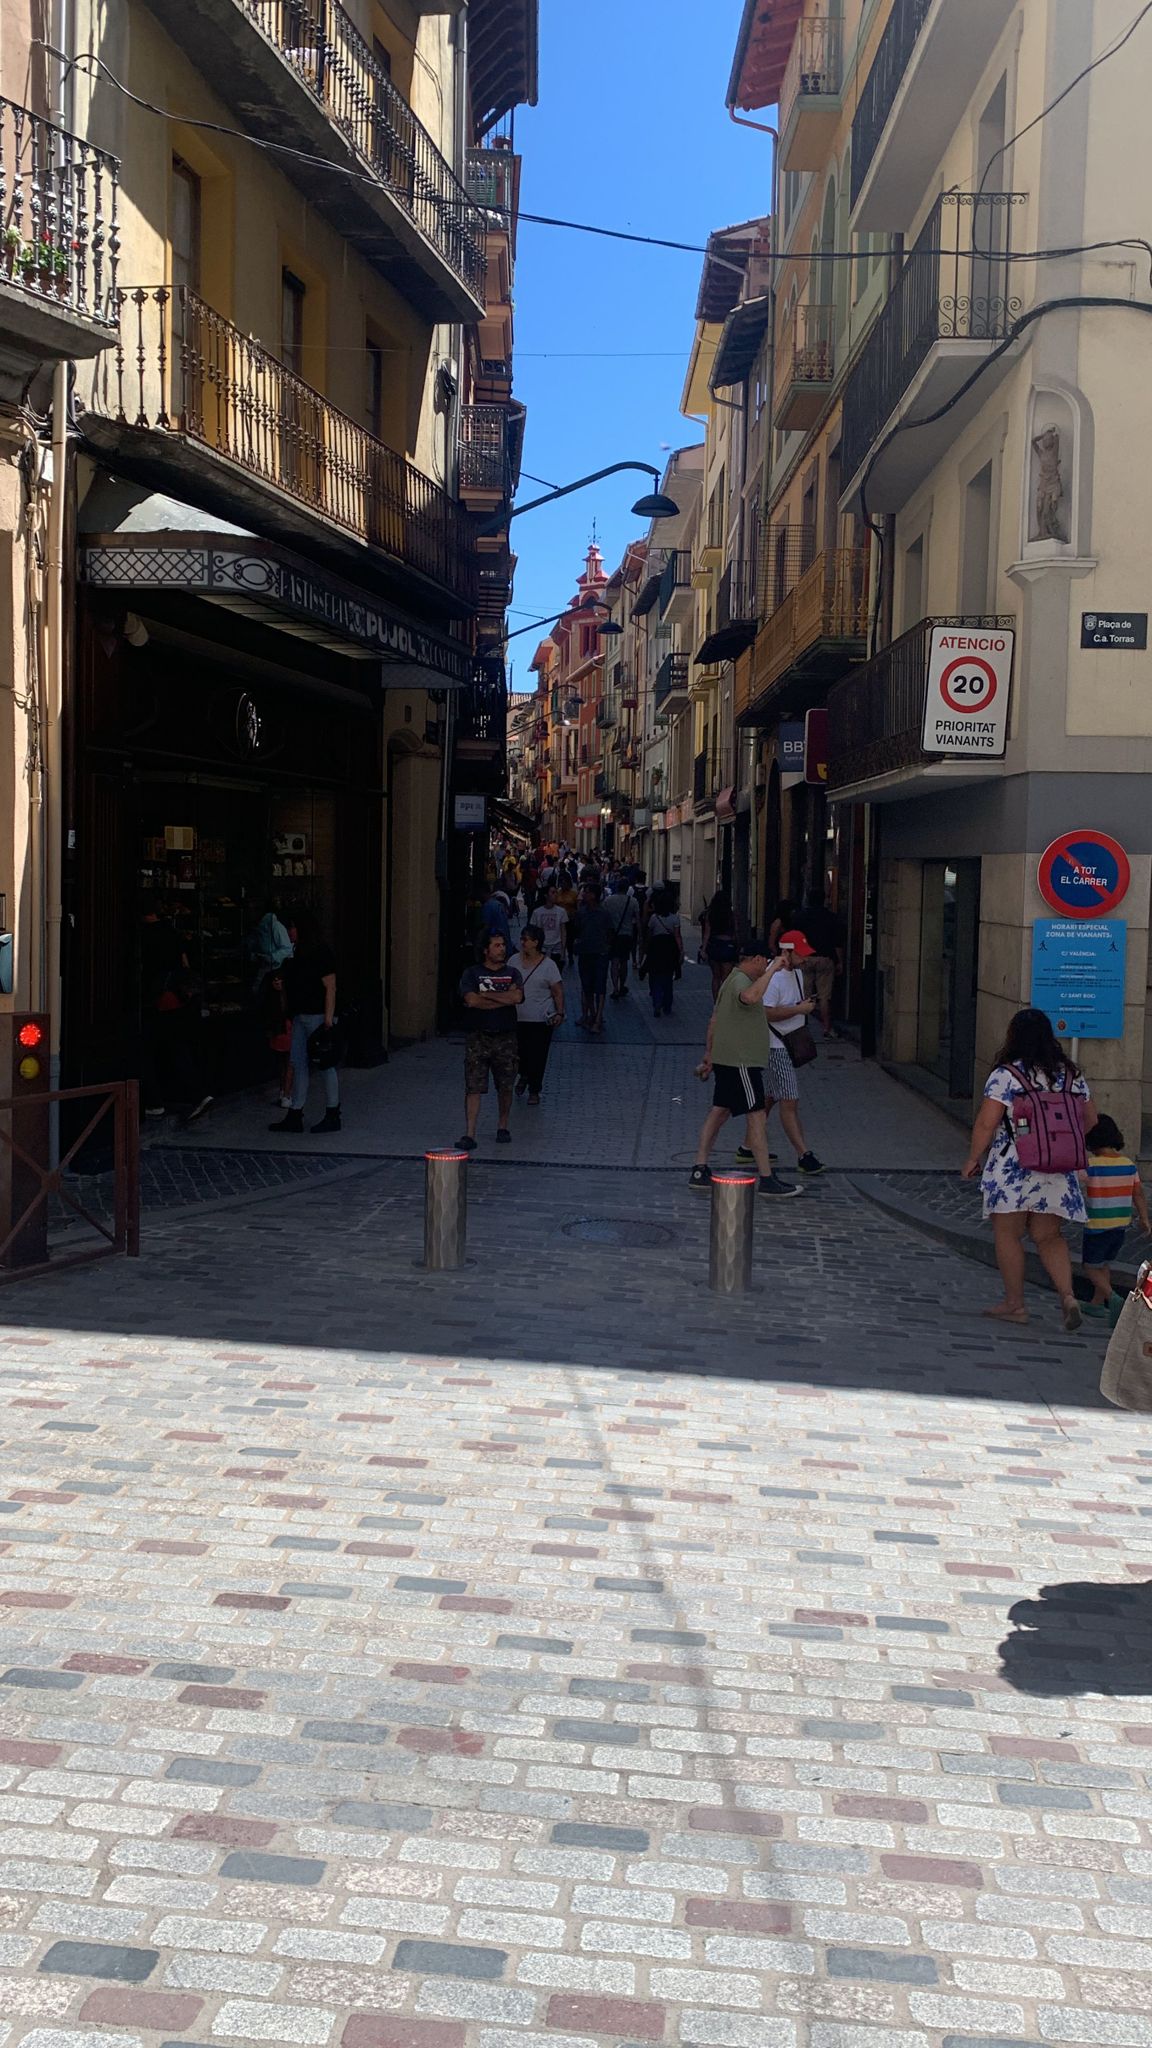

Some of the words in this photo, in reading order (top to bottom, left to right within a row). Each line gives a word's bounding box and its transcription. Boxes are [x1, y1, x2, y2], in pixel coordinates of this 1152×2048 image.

[1098, 620, 1120, 629] Plaça
[1121, 620, 1132, 628] de
[366, 611, 417, 658] PUJOL
[1109, 634, 1135, 643] Torras
[953, 675, 984, 694] 20
[935, 720, 996, 733] PRIORITAT
[936, 734, 994, 747] VIANANTS
[1073, 866, 1079, 874] A
[1081, 866, 1097, 875] TOT
[1060, 876, 1071, 884] EL
[1073, 876, 1107, 886] CARRER
